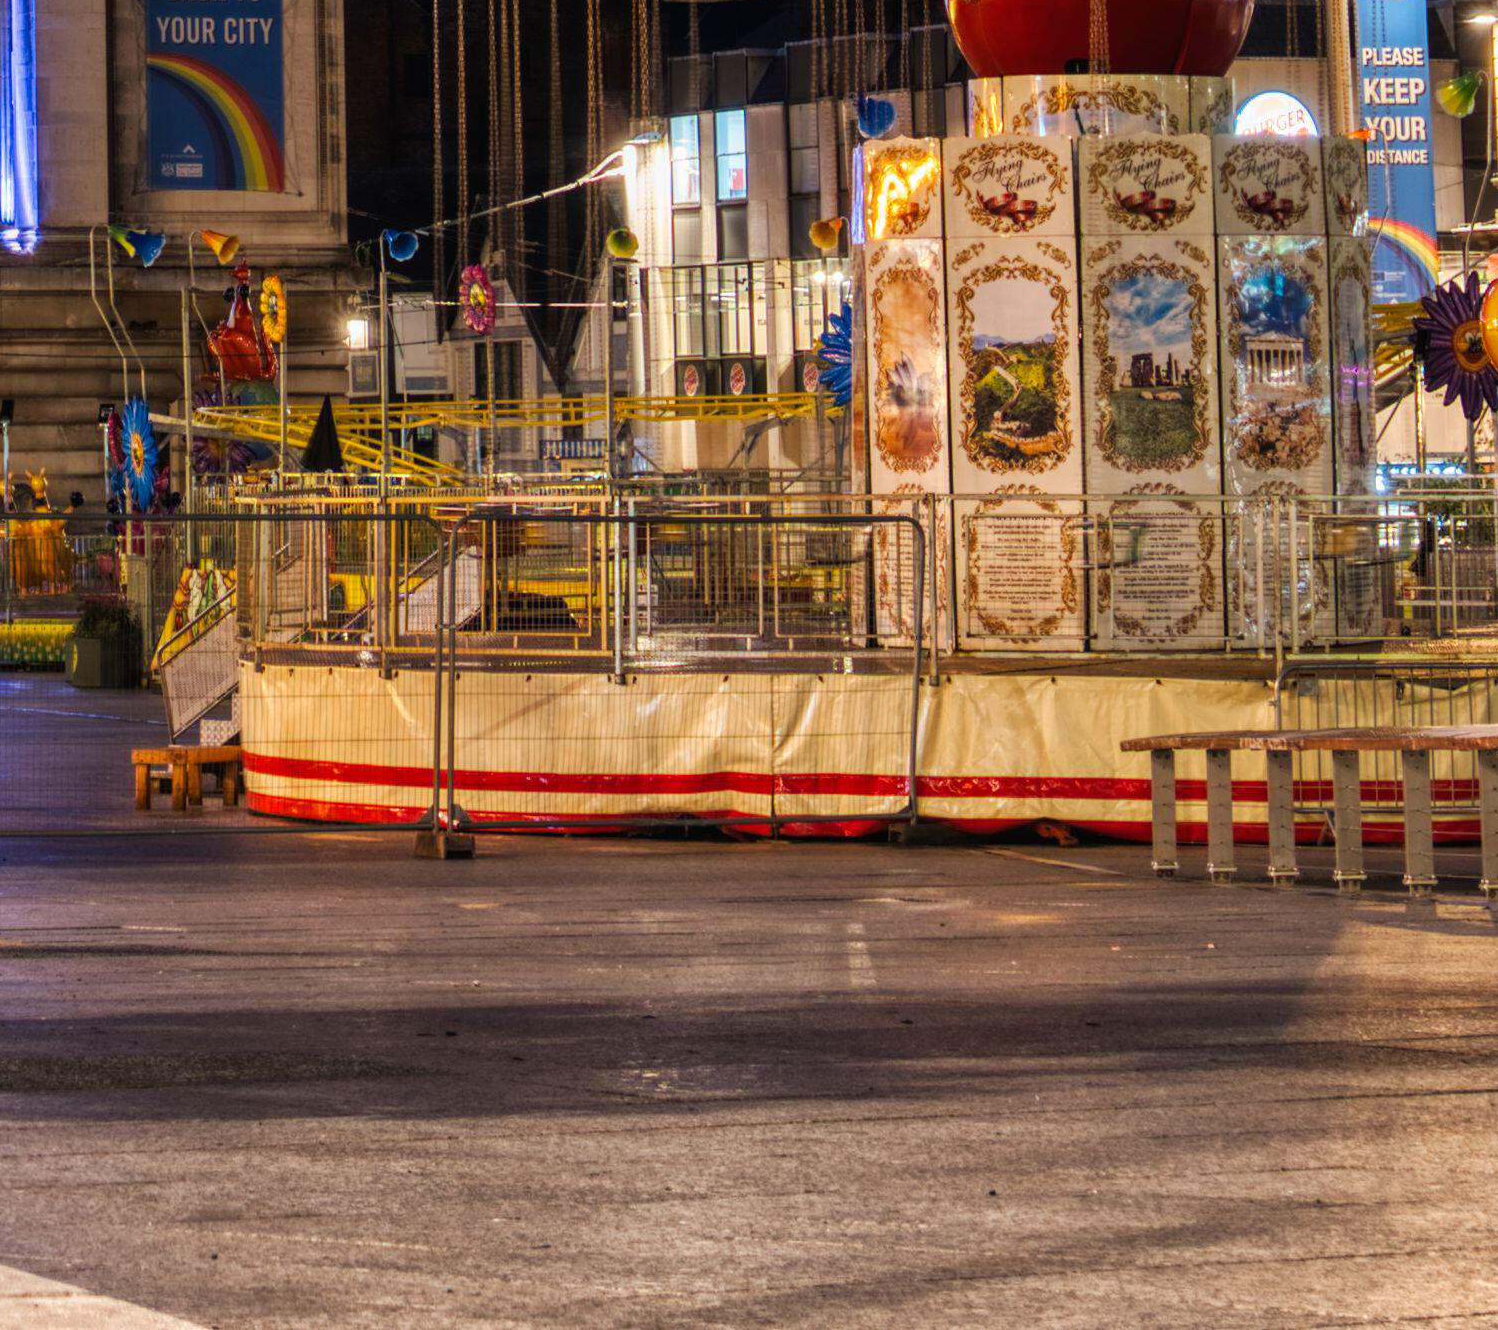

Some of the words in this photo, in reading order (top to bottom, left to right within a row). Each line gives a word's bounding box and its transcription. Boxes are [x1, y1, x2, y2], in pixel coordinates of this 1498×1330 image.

[156, 16, 216, 44] YOUR
[224, 17, 274, 44] CITY
[1361, 47, 1425, 66] PLEASE
[1363, 77, 1426, 105] KEEP
[1365, 116, 1427, 141] YOUR
[1109, 156, 1162, 182] Flying
[1237, 157, 1280, 181] Flying
[1367, 149, 1429, 165] DISTANCE
[972, 158, 1023, 183] Flying
[1005, 172, 1048, 193] Chairs
[1139, 172, 1186, 193] Chairs
[1262, 172, 1301, 192] Chairs
